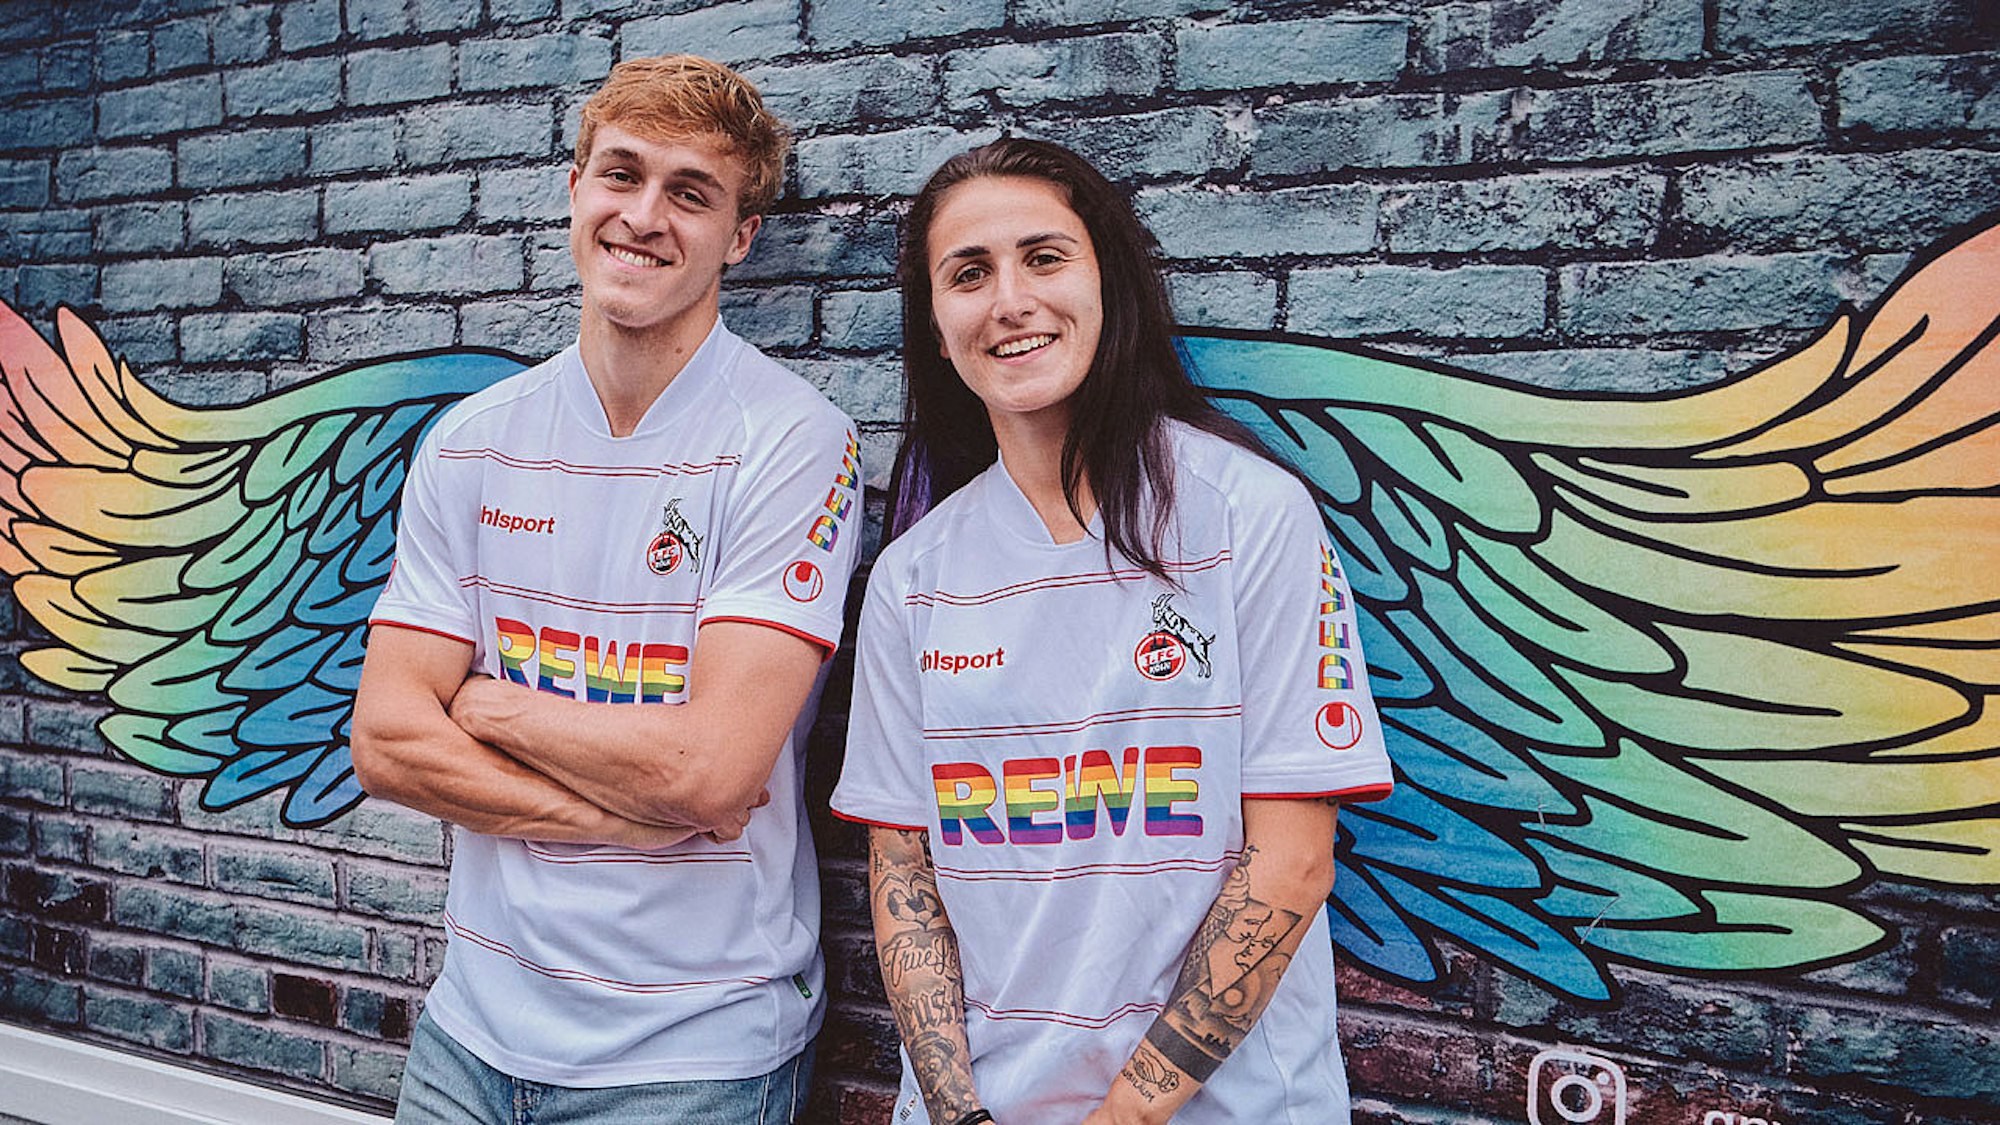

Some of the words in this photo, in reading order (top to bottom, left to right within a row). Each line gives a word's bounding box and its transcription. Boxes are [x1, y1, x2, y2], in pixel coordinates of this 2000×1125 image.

[479, 505, 555, 534] hlsport
[1317, 539, 1354, 690] DEVK
[495, 616, 688, 704] REWE
[931, 746, 1204, 846] REWE
[881, 936, 932, 988] True
